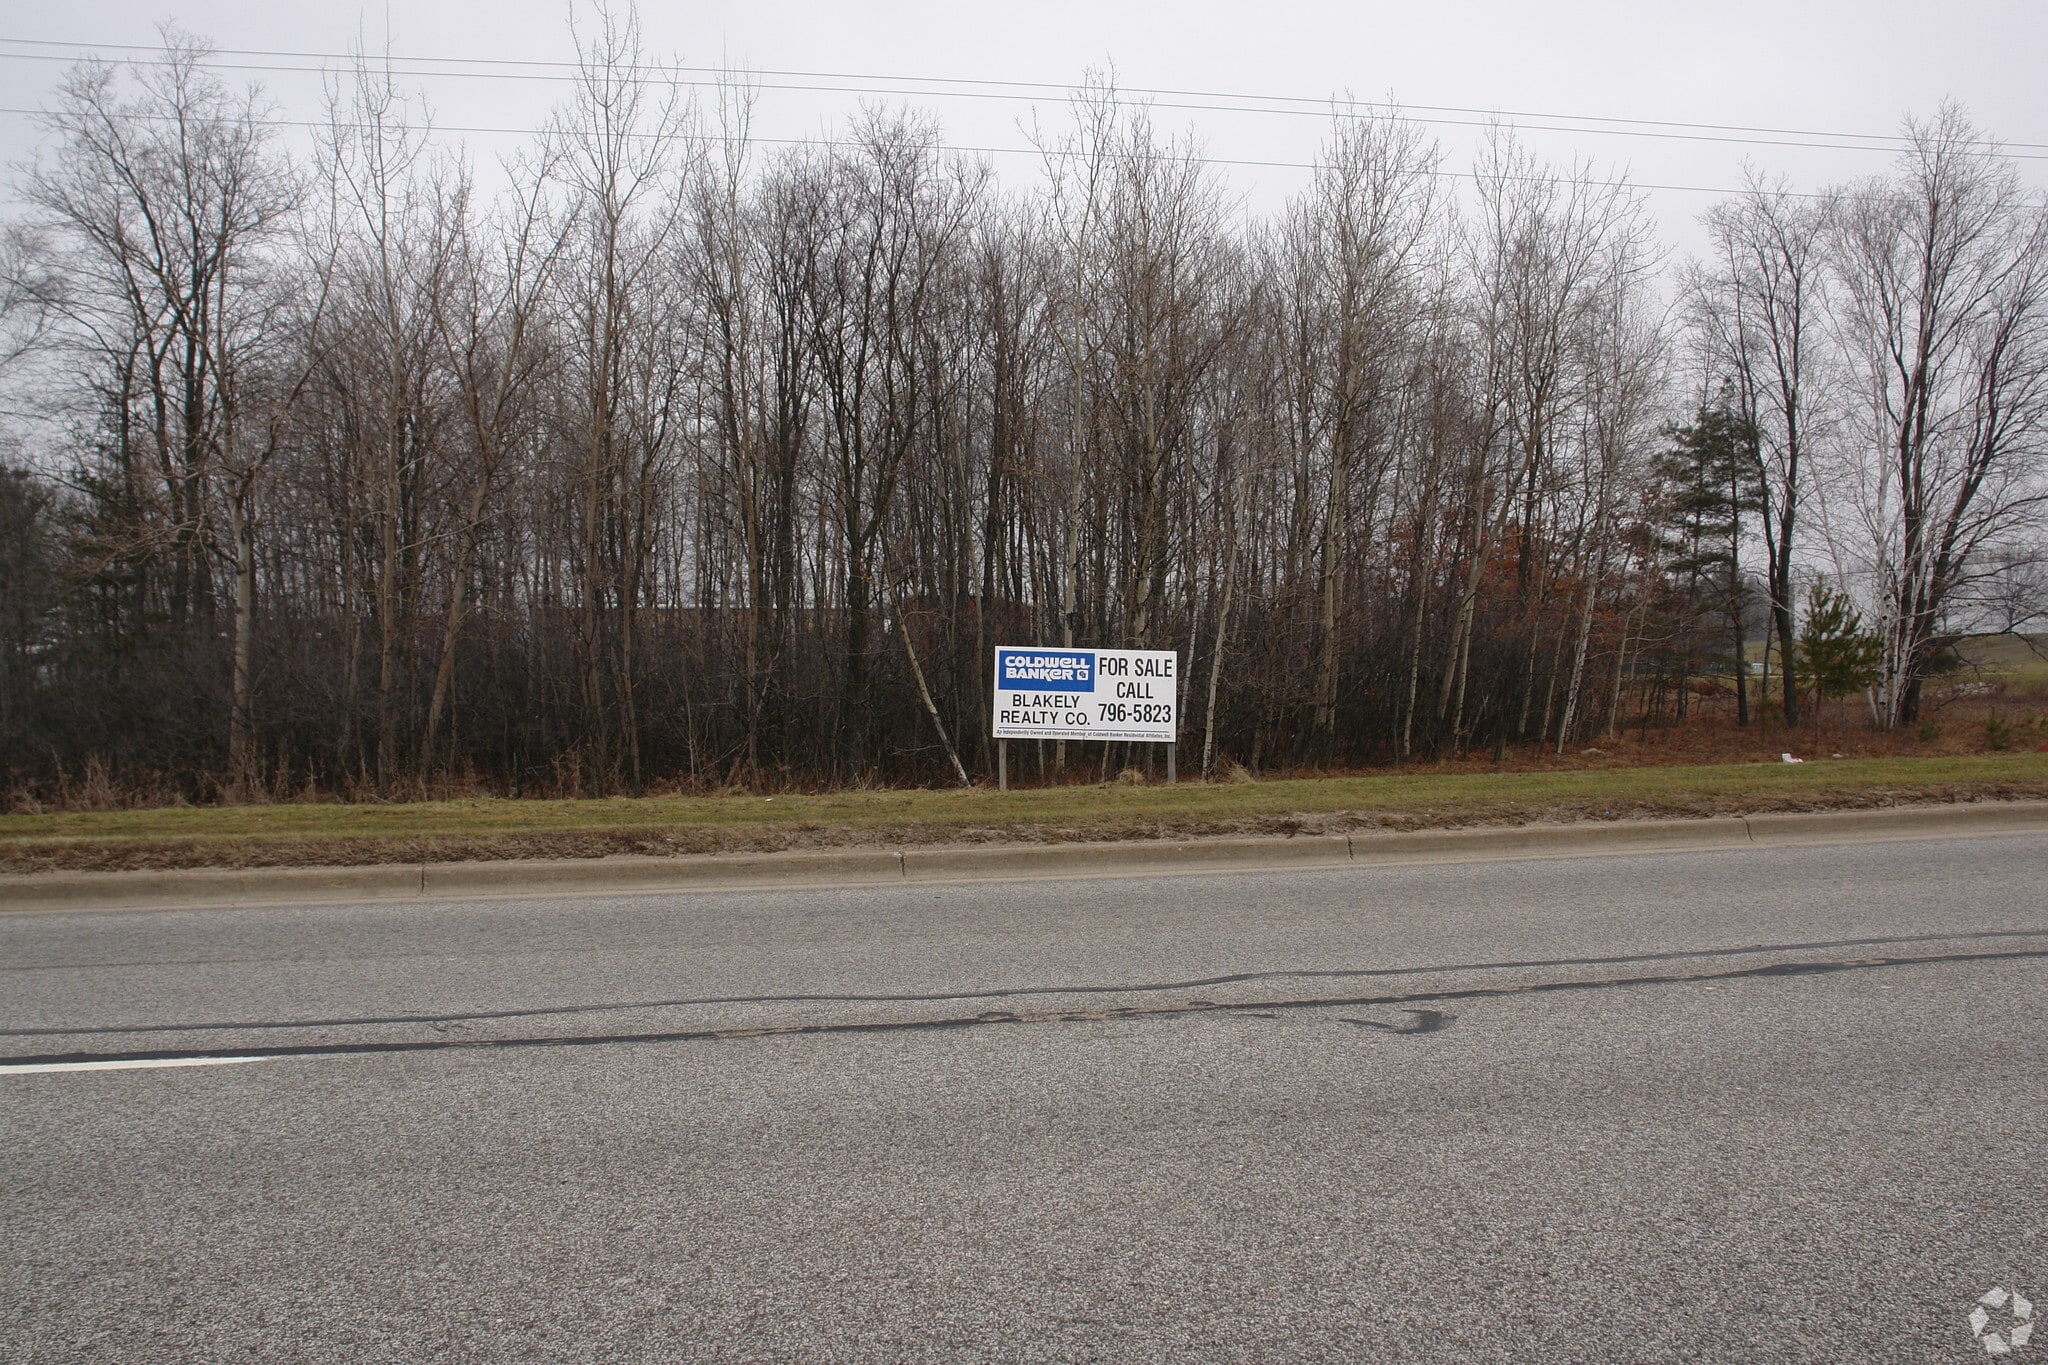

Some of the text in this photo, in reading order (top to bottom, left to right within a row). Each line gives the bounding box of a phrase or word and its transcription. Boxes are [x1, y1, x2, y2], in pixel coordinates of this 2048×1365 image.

[1005, 656, 1090, 669] COLDWELL
[1099, 657, 1128, 676] FOR
[1135, 658, 1172, 678] SALE
[1005, 668, 1074, 682] BANKER
[1116, 681, 1154, 699] CALL
[1012, 694, 1080, 708] BLAKELY
[1000, 711, 1090, 726] REALTY CO.
[1098, 703, 1171, 723] 796-5823
